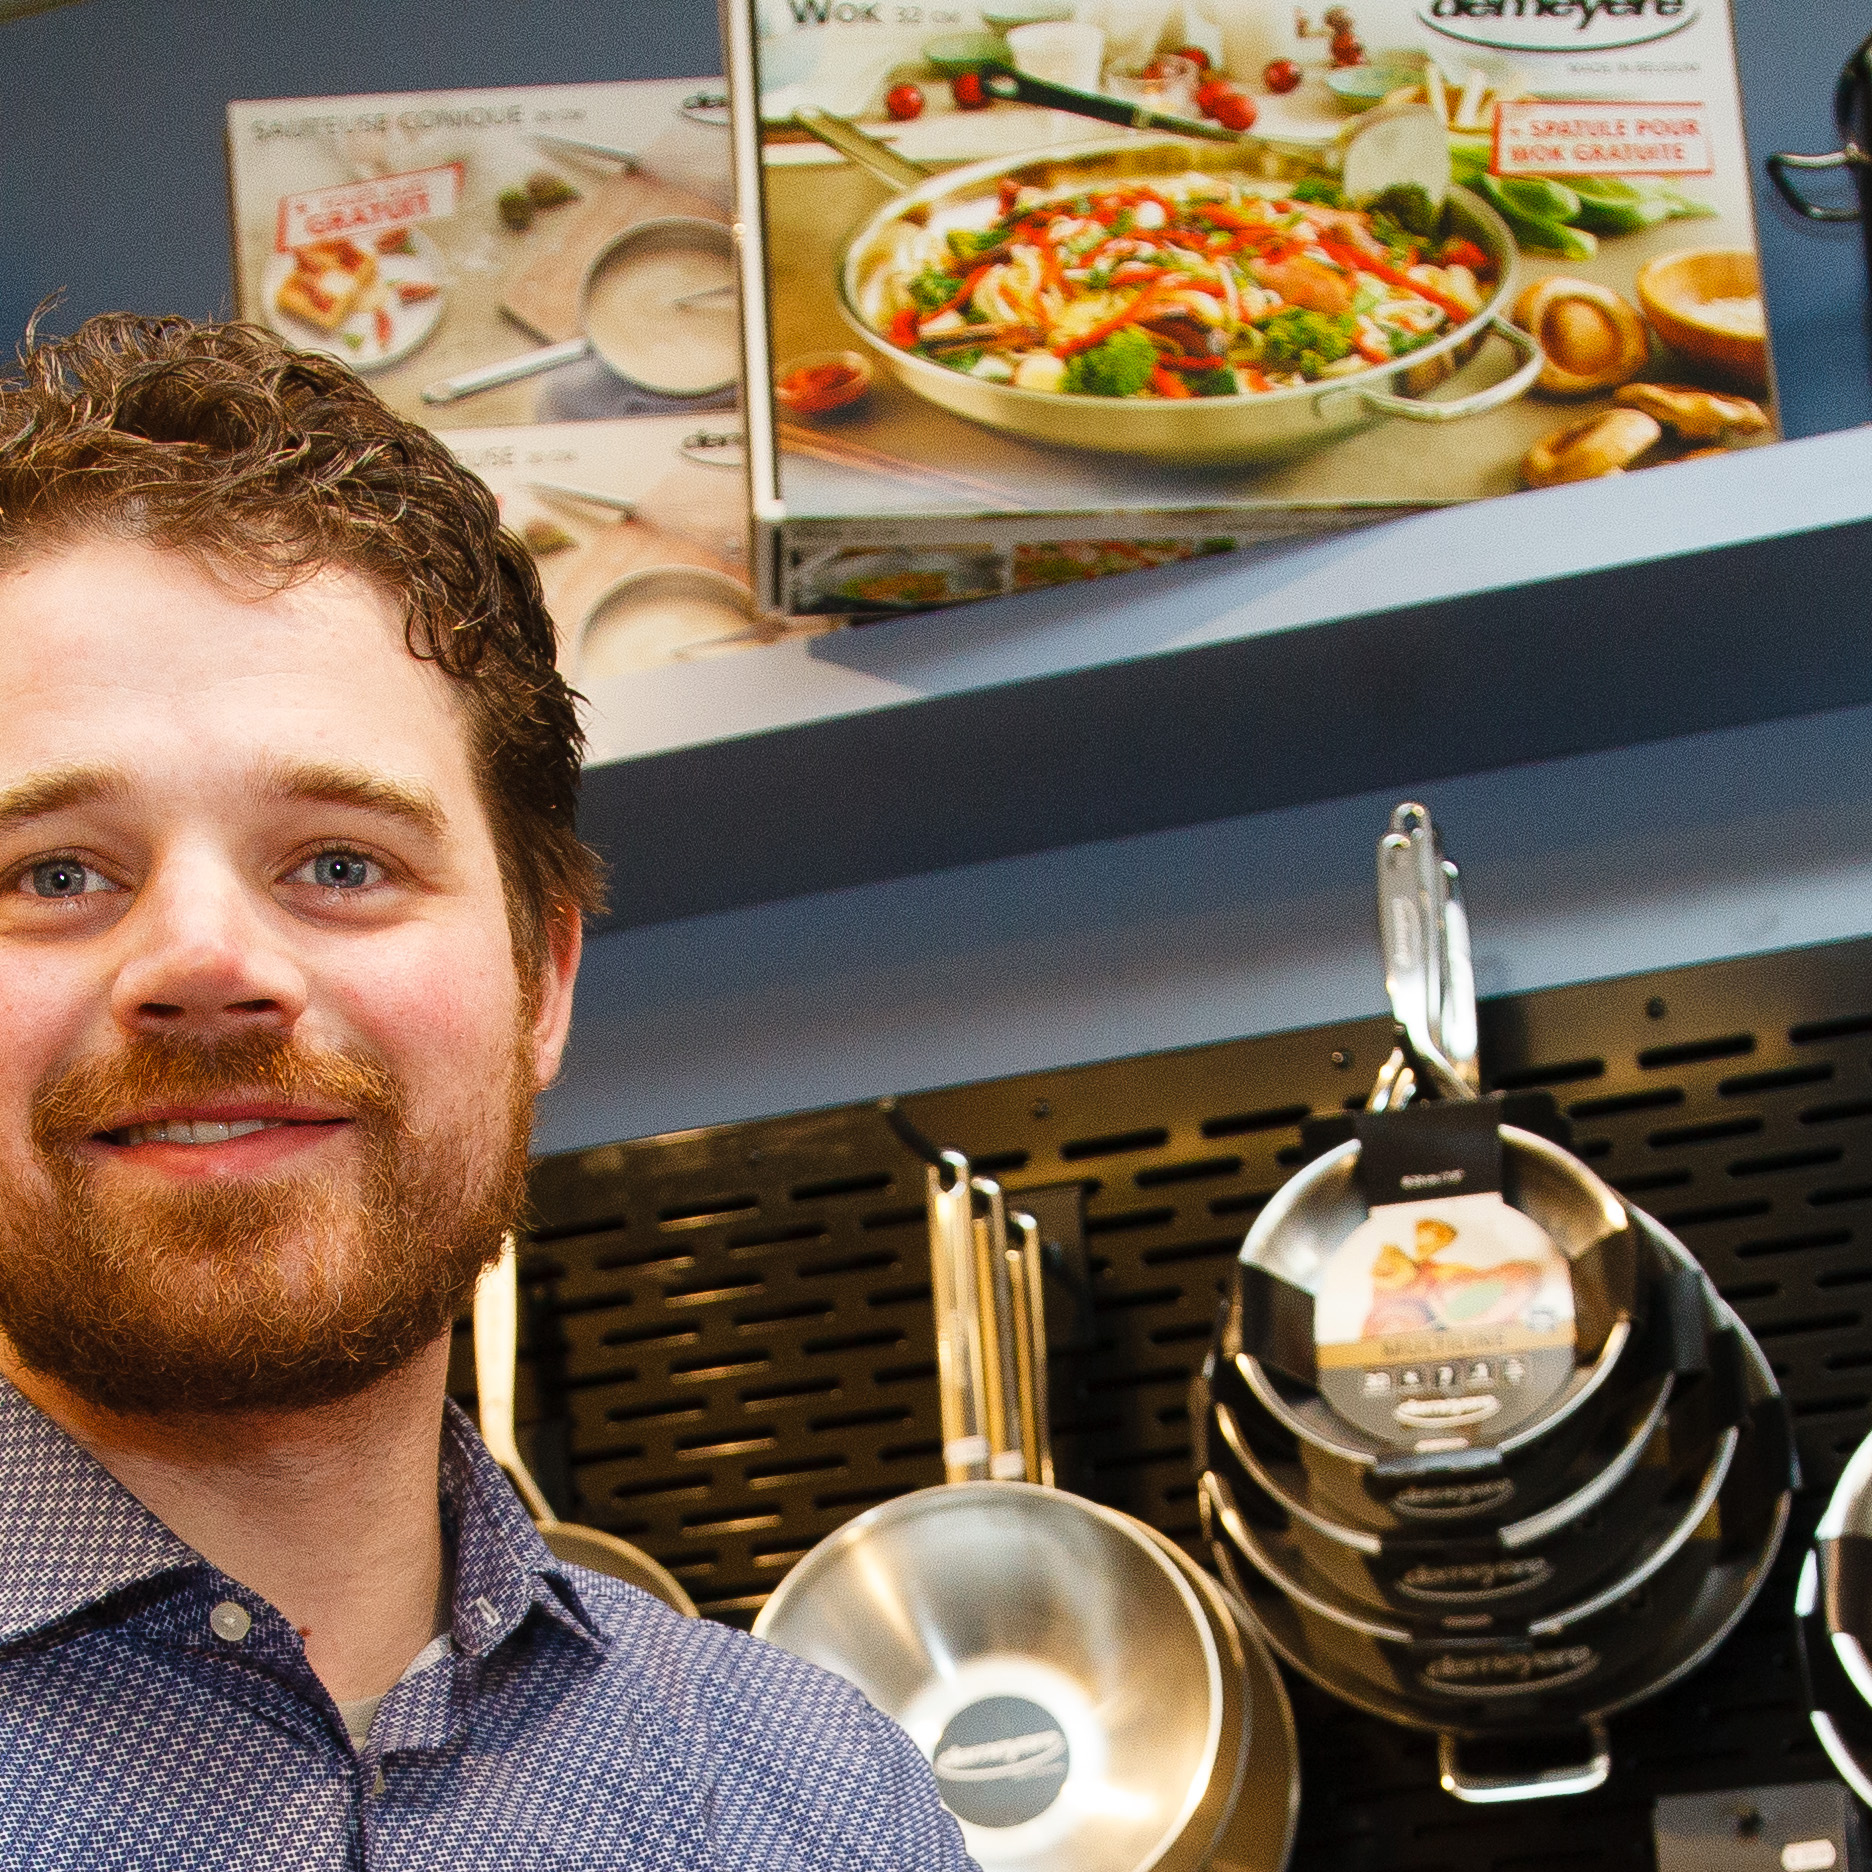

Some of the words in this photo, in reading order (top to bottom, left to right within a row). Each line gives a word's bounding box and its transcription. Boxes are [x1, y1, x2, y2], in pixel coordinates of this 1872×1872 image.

[398, 104, 525, 132] CONIQUE
[1529, 118, 1627, 139] SPATULE
[1635, 117, 1701, 138] POUR
[1510, 144, 1565, 164] WOK
[1572, 142, 1686, 163] GRATUITE
[304, 191, 432, 236] GRATUIT
